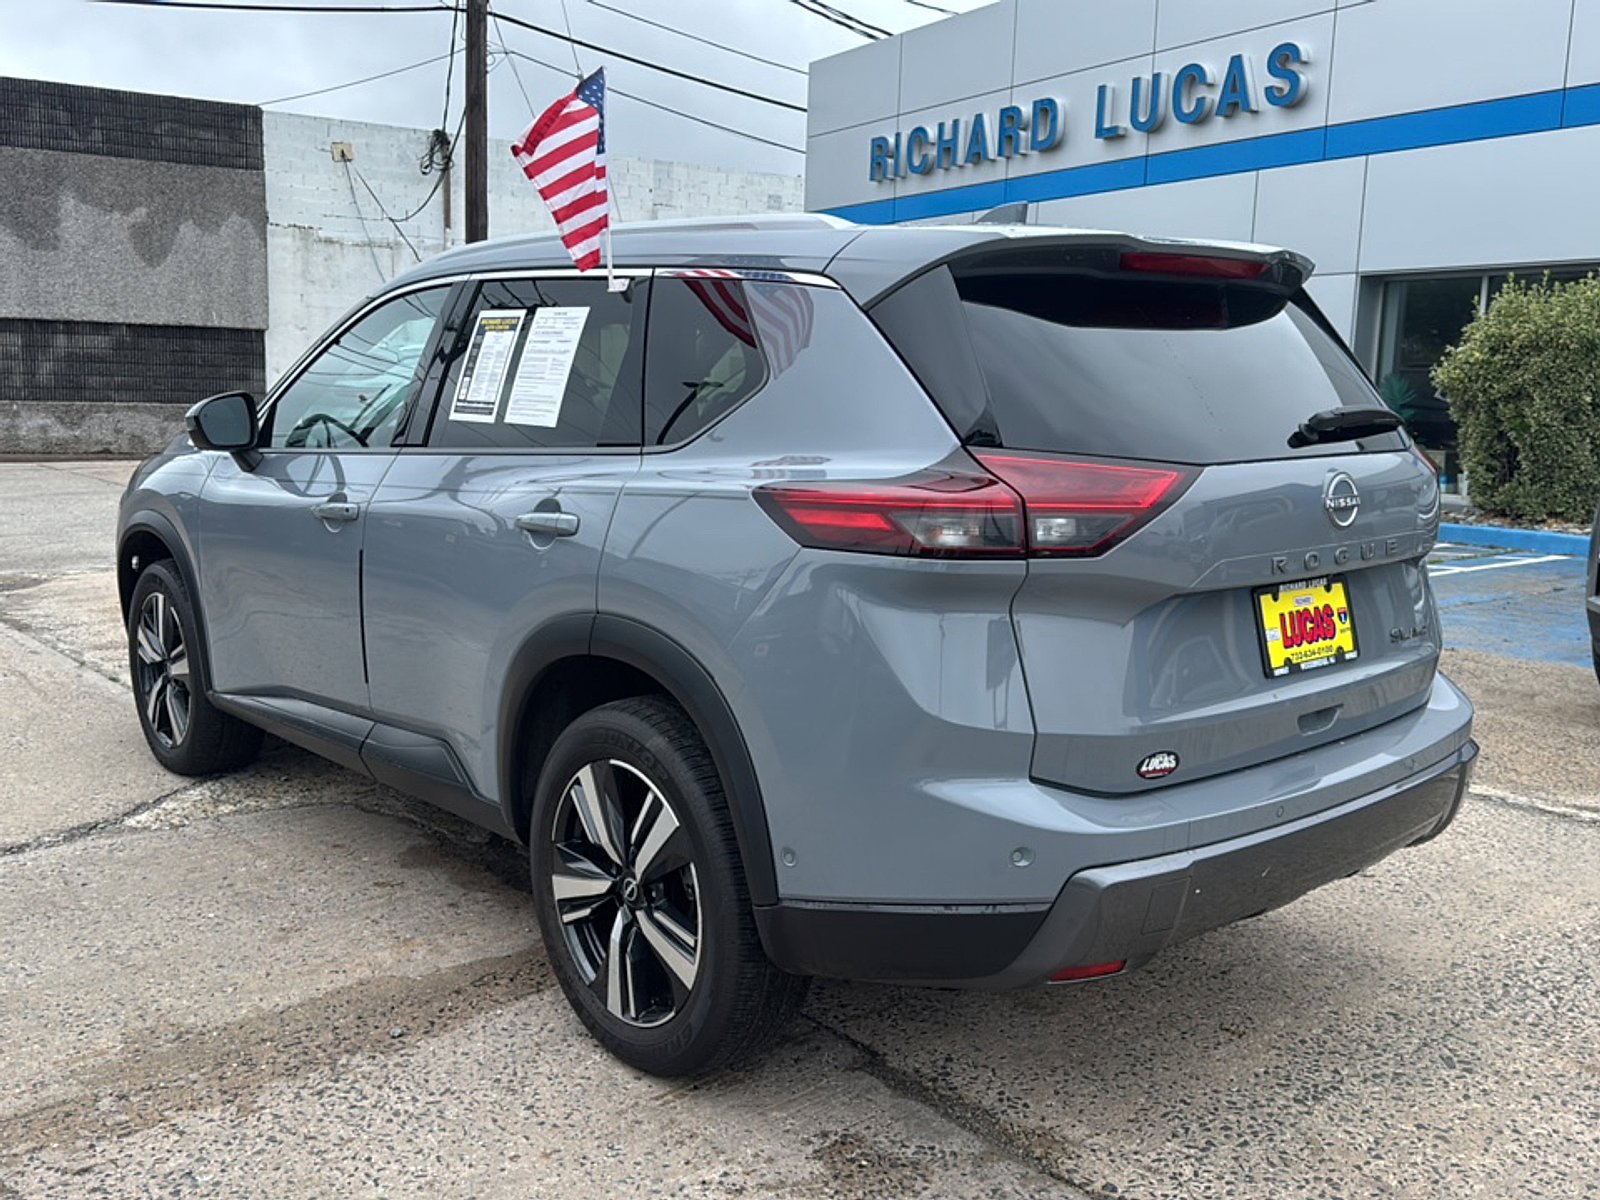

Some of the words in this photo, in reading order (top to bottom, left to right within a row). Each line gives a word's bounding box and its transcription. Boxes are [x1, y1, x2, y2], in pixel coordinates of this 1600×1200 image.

[869, 97, 1061, 183] RICHARD
[1095, 41, 1306, 139] LUCAS
[1326, 496, 1361, 509] NISSAN
[1271, 540, 1399, 575] ROGUE
[1279, 604, 1337, 648] LUCAS
[1140, 753, 1177, 772] LUCAS
